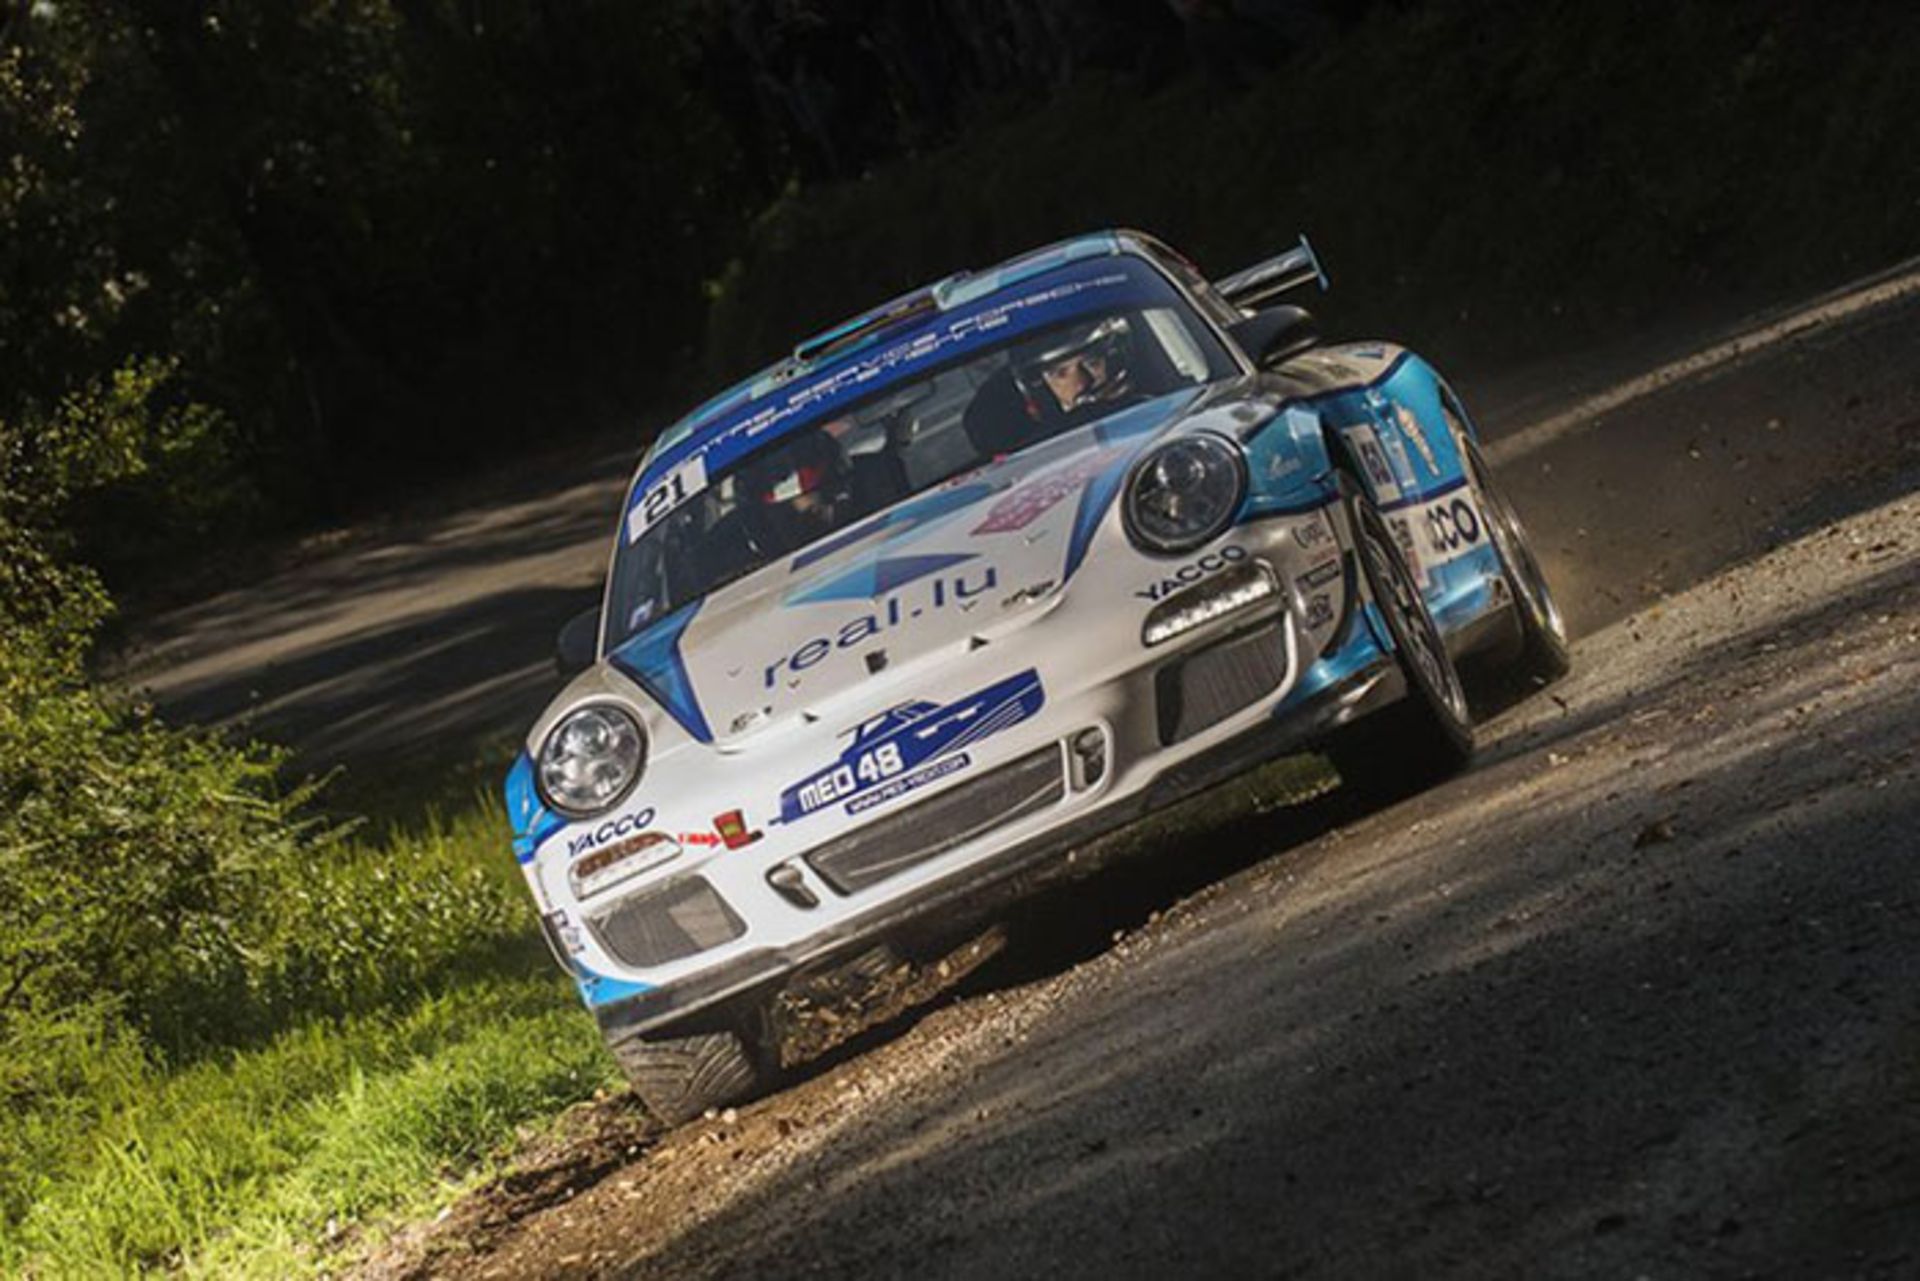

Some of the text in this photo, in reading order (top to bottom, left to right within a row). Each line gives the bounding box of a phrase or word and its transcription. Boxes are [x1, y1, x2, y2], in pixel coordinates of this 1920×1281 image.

[643, 473, 688, 524] 21
[1135, 544, 1249, 602] YACCO
[763, 567, 998, 688] real.lu
[857, 741, 905, 783] 48
[567, 807, 656, 857] YACCO
